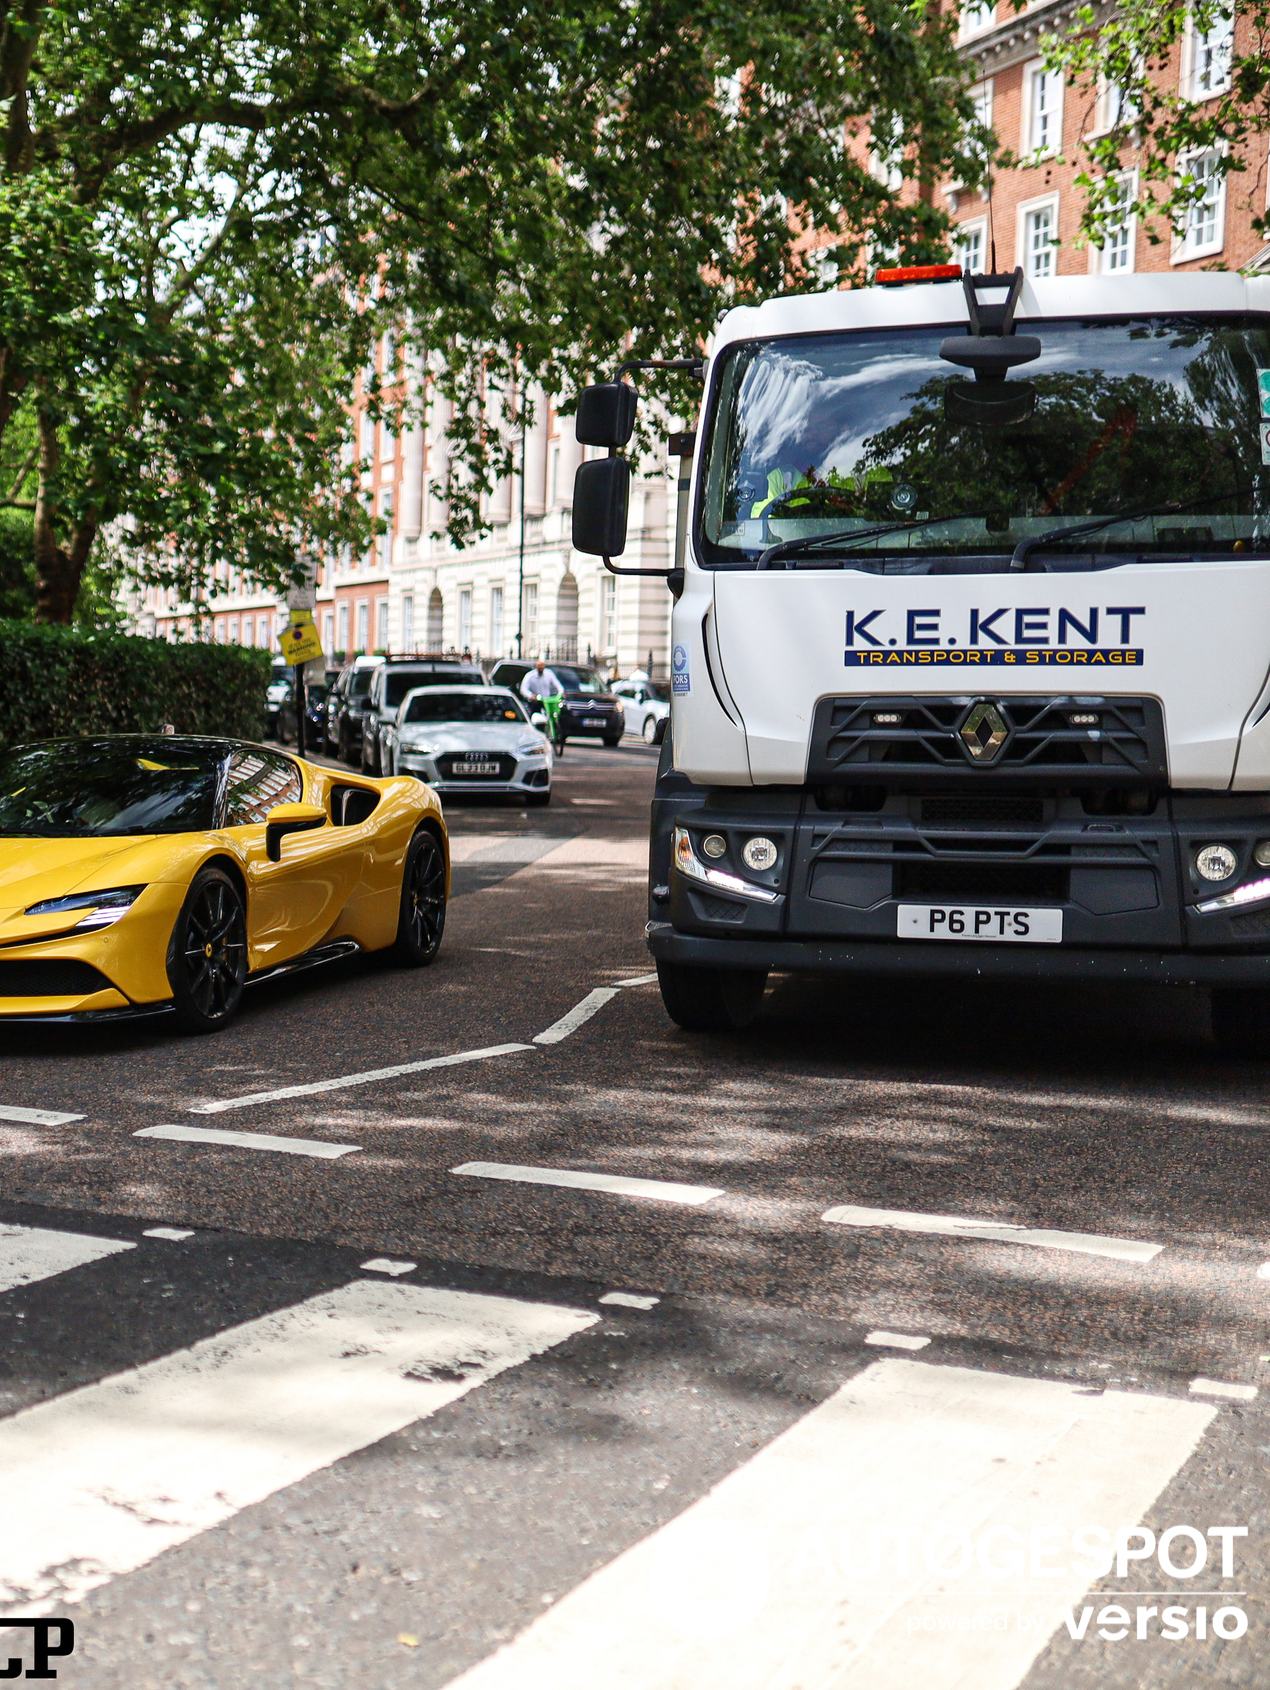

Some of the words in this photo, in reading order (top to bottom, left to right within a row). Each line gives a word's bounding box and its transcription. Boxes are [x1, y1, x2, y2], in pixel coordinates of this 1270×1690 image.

[857, 651, 995, 664] TRANSPORT
[1004, 651, 1016, 663] &
[1026, 651, 1137, 664] STORAGE
[930, 909, 965, 934] P6
[974, 910, 1030, 936] PTS
